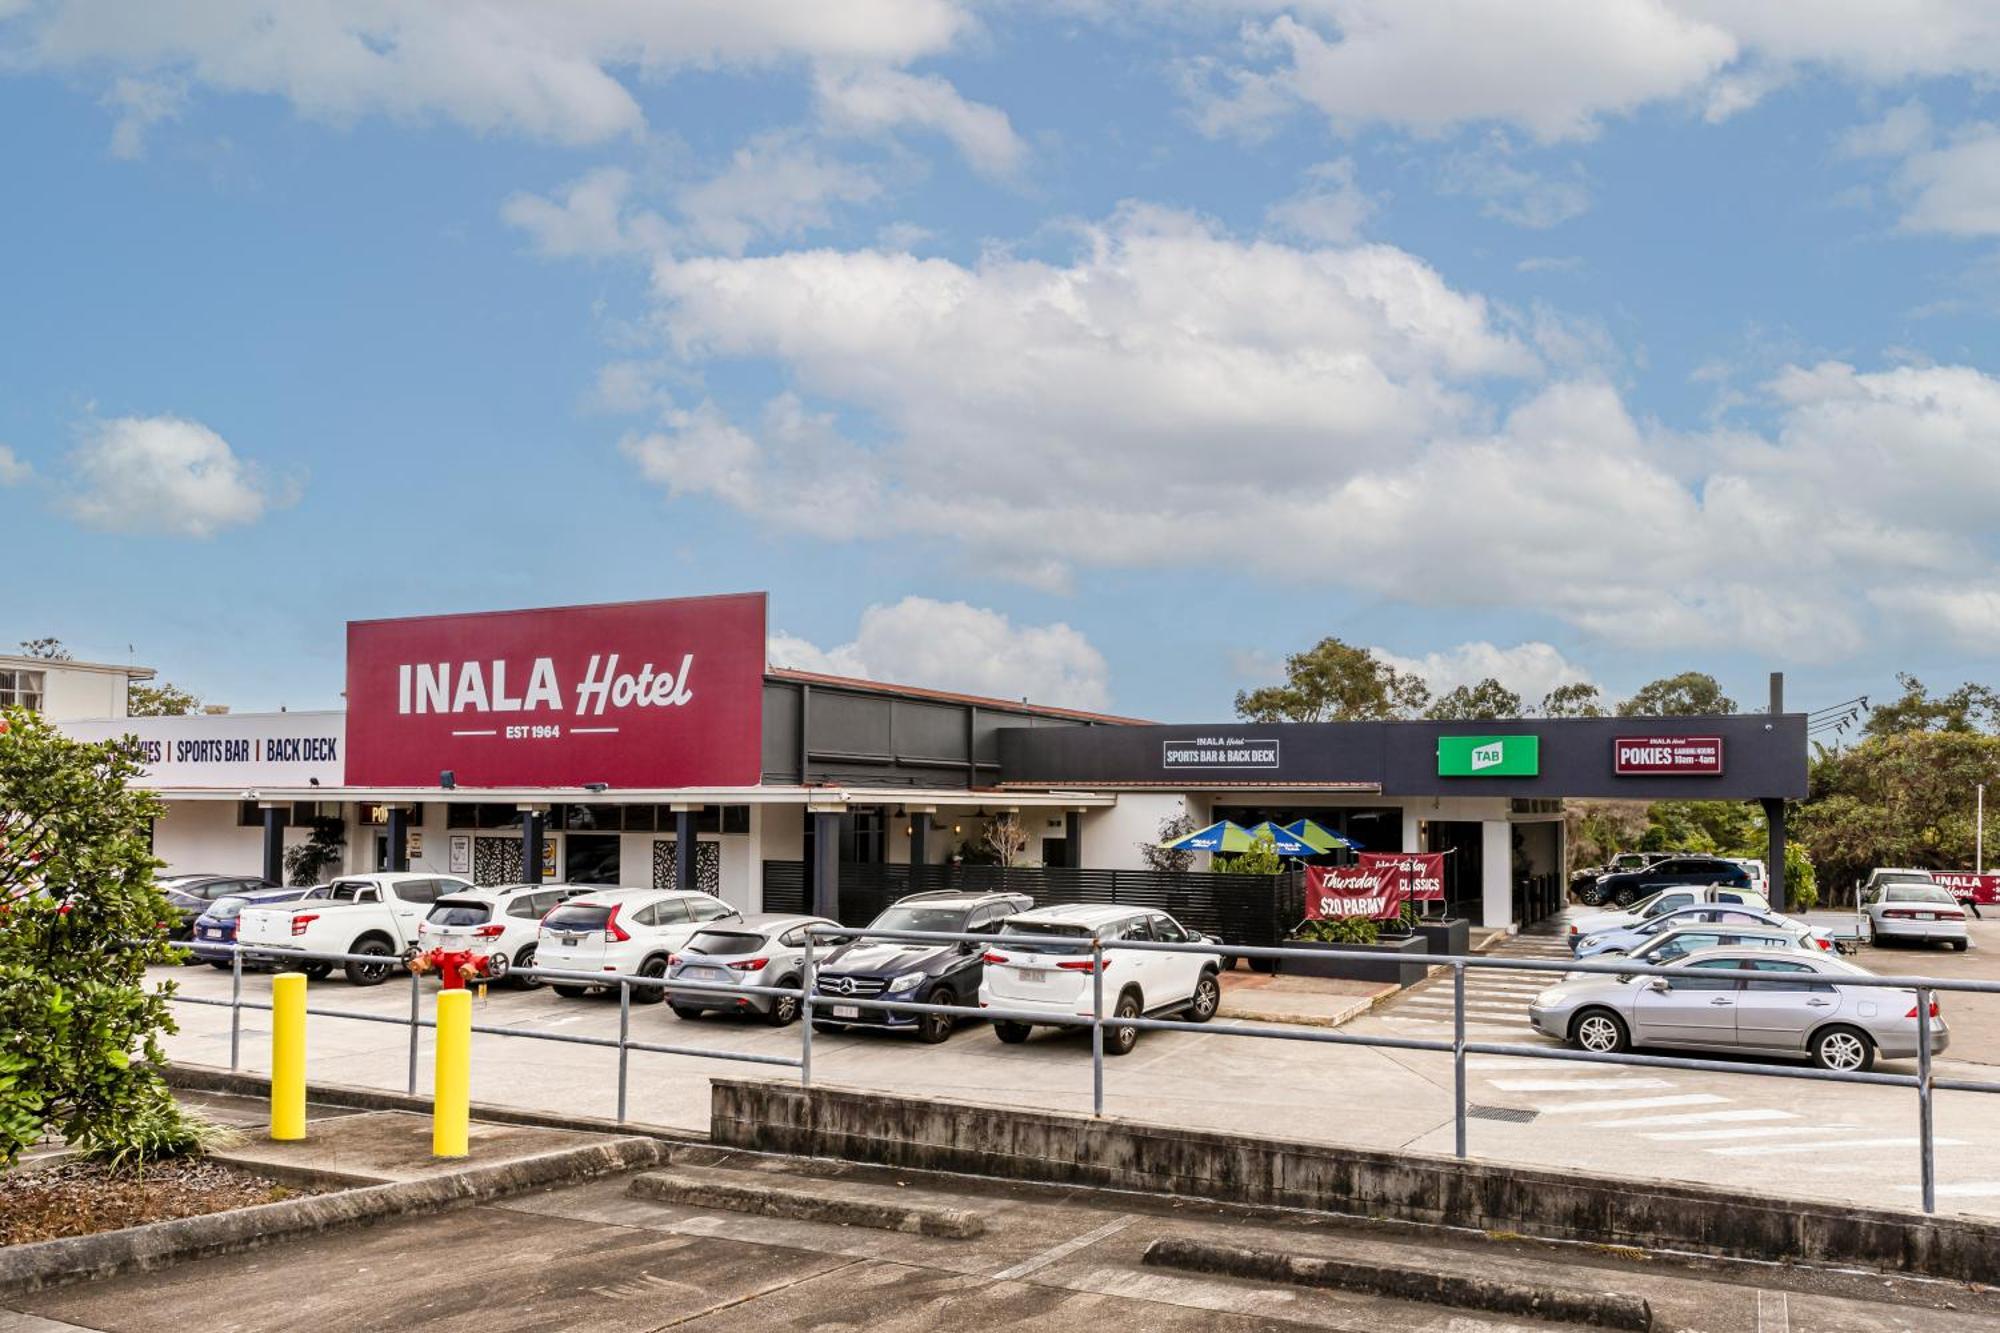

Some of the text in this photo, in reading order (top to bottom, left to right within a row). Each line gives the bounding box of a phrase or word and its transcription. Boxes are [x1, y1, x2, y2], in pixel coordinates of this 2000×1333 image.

[399, 653, 694, 715] INALA Hotel
[506, 725, 560, 739] EST 1964
[177, 739, 250, 762] SPORTS BAR
[266, 737, 337, 762] BACK DECK
[1197, 738, 1225, 746] INALA
[1167, 750, 1275, 762] SPORTS BAR & BACK DECK
[1475, 751, 1500, 762] TAB
[1620, 748, 1672, 765] POKIES
[1322, 871, 1381, 896] Thursday
[1935, 876, 1982, 887] INALA
[1320, 896, 1386, 915] $20 PARMY
